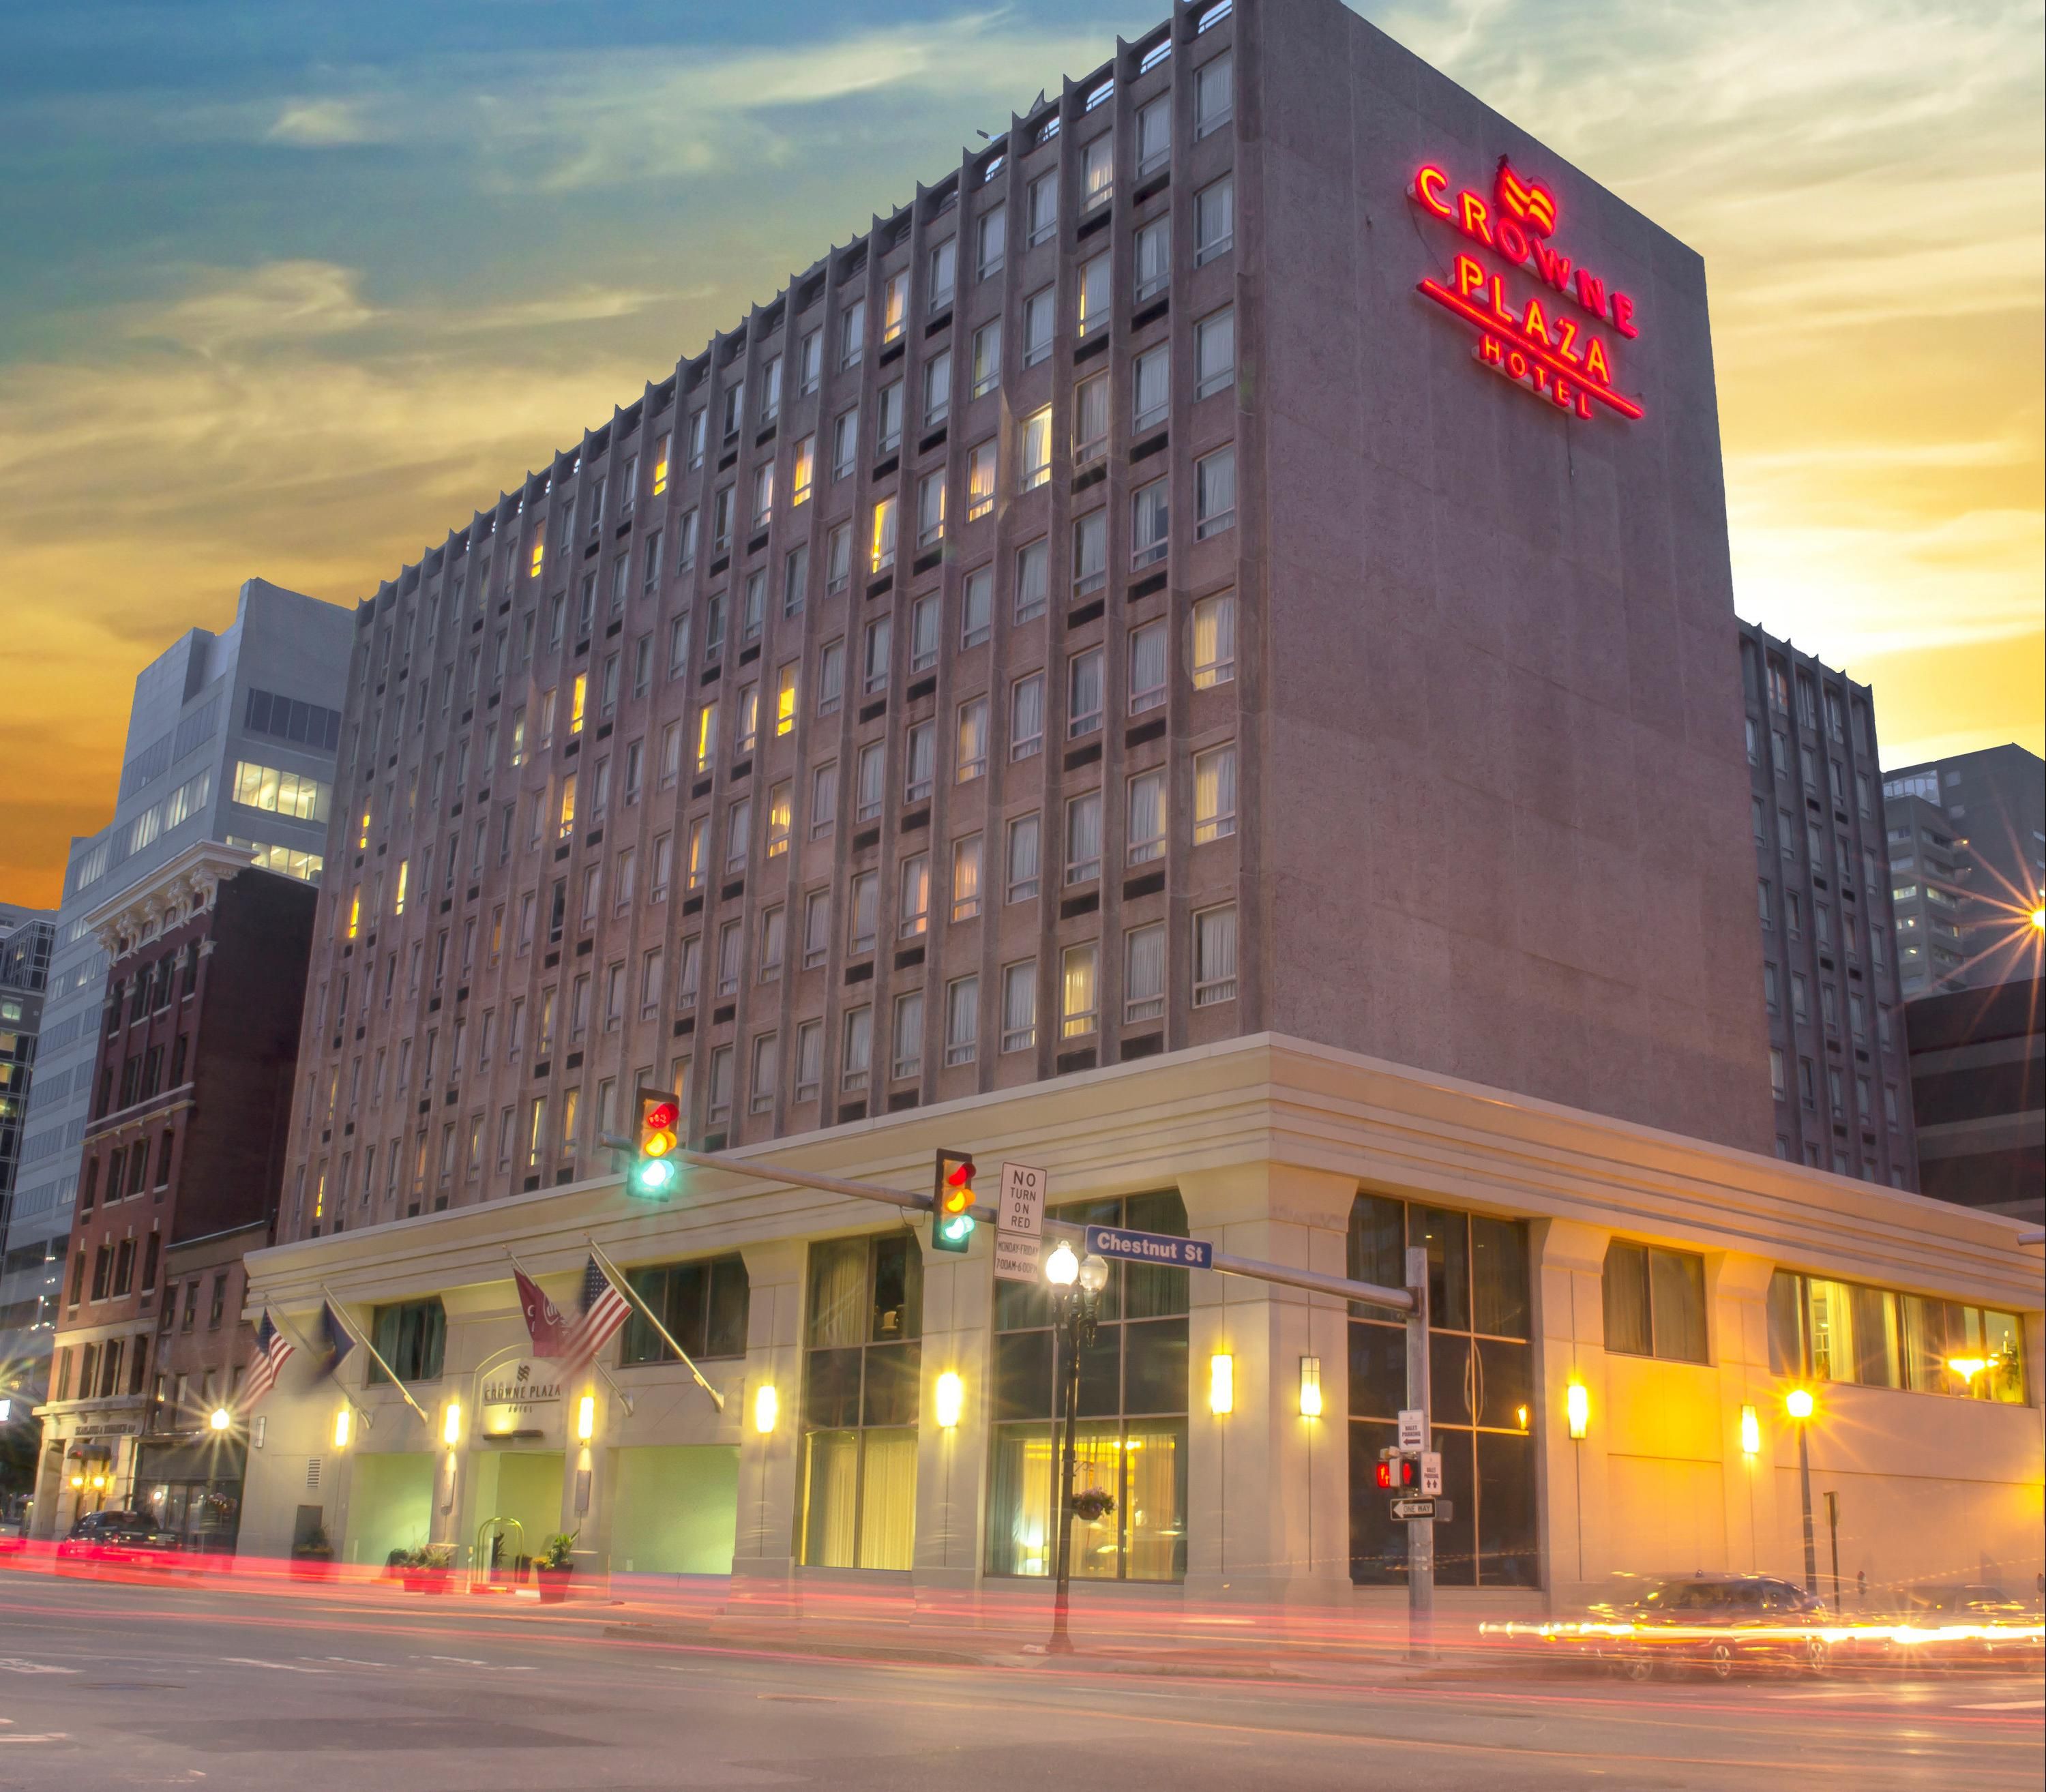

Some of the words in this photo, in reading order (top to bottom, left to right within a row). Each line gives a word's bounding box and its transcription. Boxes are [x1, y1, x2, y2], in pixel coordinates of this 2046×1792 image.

[1415, 165, 1637, 339] CROWNE
[1454, 252, 1610, 386] PLAZA
[1479, 334, 1592, 419] HOTEL
[1013, 1169, 1036, 1187] NO
[1011, 1187, 1037, 1201] TURN
[1014, 1202, 1029, 1214] ON
[1011, 1215, 1031, 1228] RED
[1097, 1231, 1178, 1259] Chestnut
[1184, 1244, 1203, 1262] St
[484, 1385, 525, 1401] CROWNE
[529, 1384, 561, 1398] PLAZA
[1403, 1505, 1416, 1513] ONE
[1418, 1504, 1431, 1512] WAY
